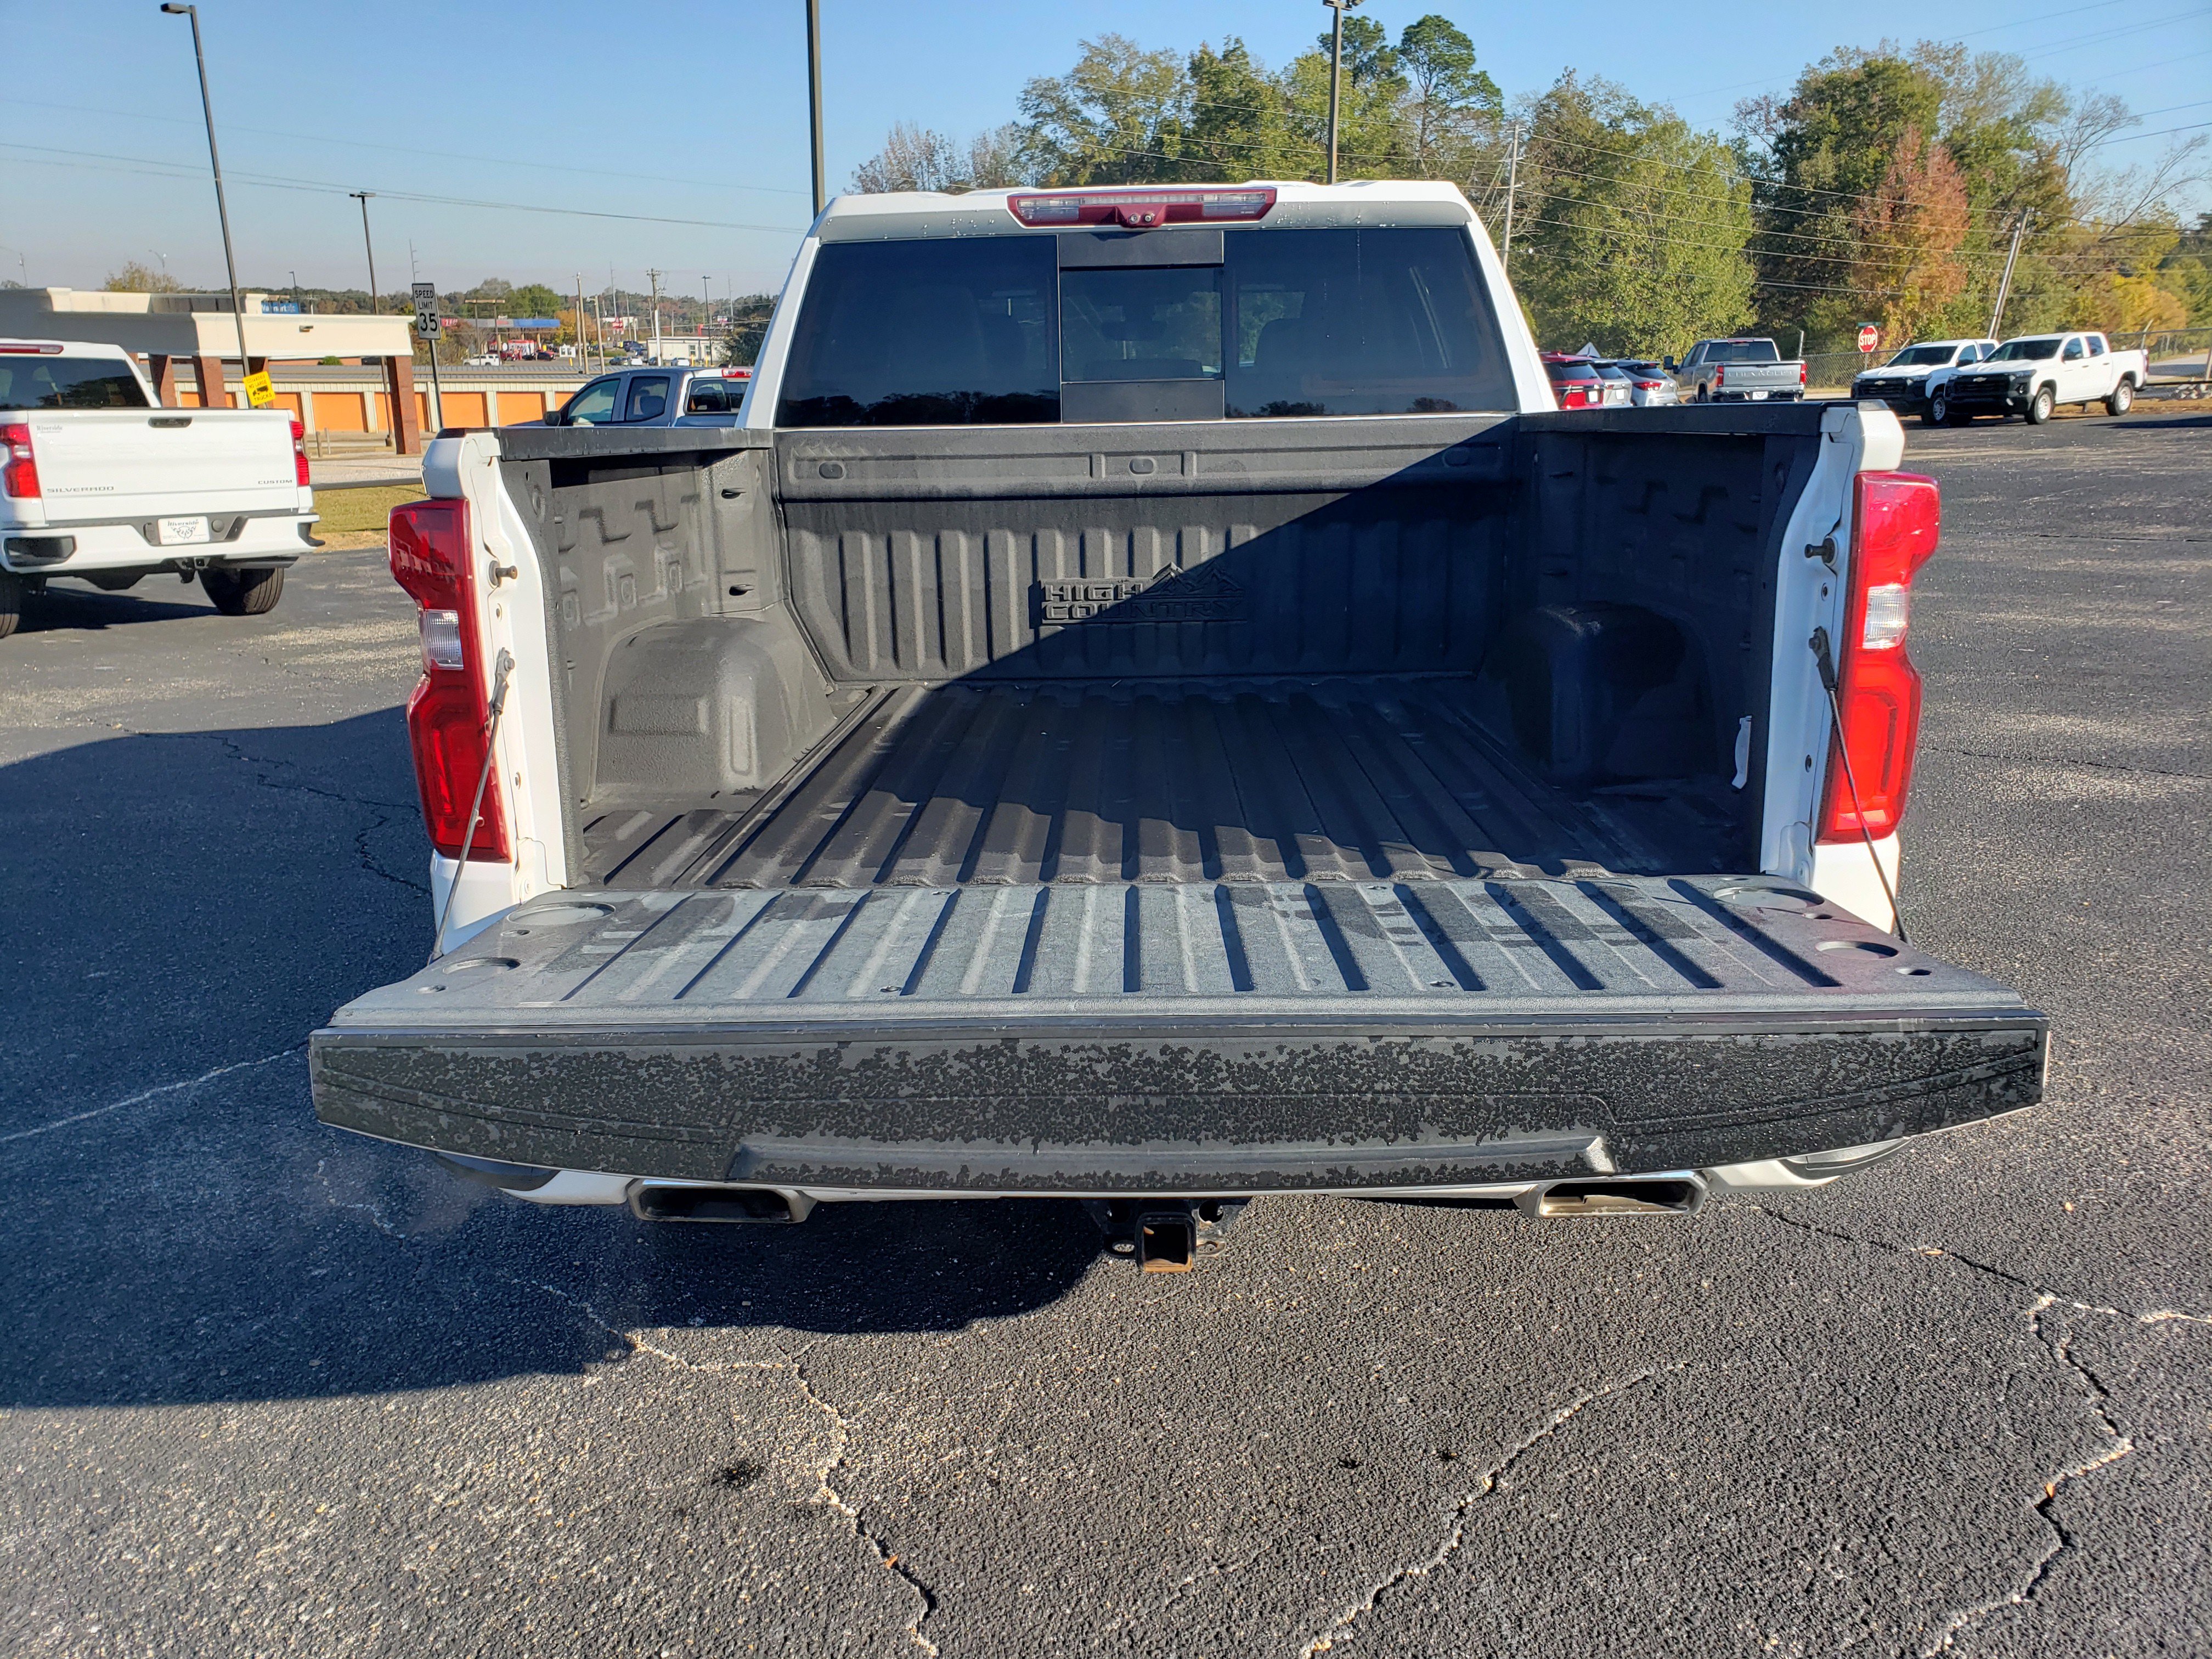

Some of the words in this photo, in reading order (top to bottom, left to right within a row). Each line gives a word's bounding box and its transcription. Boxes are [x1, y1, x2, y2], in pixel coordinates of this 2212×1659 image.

[415, 290, 434, 298] SPEED
[418, 301, 433, 309] LIMIT
[419, 312, 437, 331] 35
[1860, 334, 1876, 346] STOP
[254, 393, 272, 402] TRUCKS
[1043, 583, 1143, 601] HIGH
[1043, 602, 1242, 620] COUNTRY
